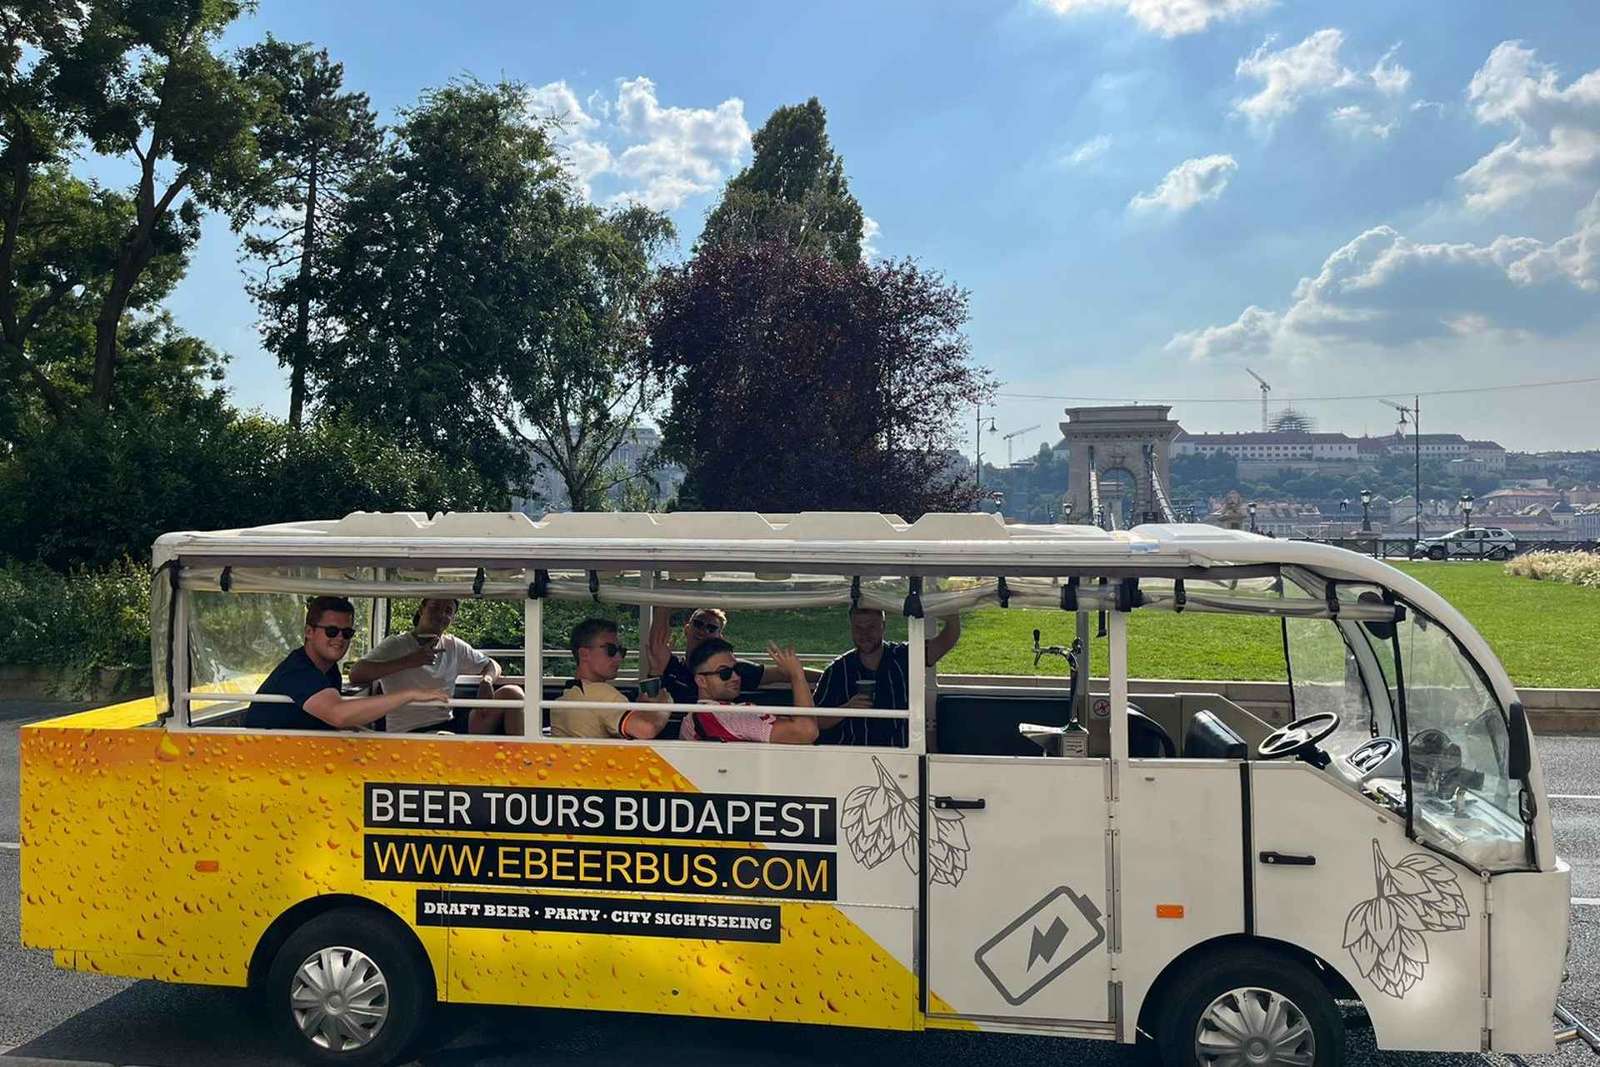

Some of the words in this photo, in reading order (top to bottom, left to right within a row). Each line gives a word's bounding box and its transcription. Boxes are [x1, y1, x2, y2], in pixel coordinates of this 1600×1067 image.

[371, 788, 472, 825] BEER
[483, 792, 605, 828] TOURS
[614, 796, 829, 838] BUDAPEST
[373, 841, 828, 893] WWW.EBEERBUS.COM
[424, 902, 480, 916] DRAFT
[484, 904, 531, 918] BEER
[544, 907, 600, 922] PARTY
[611, 910, 652, 925] CITY
[654, 912, 772, 930] SIGHTSEEING
